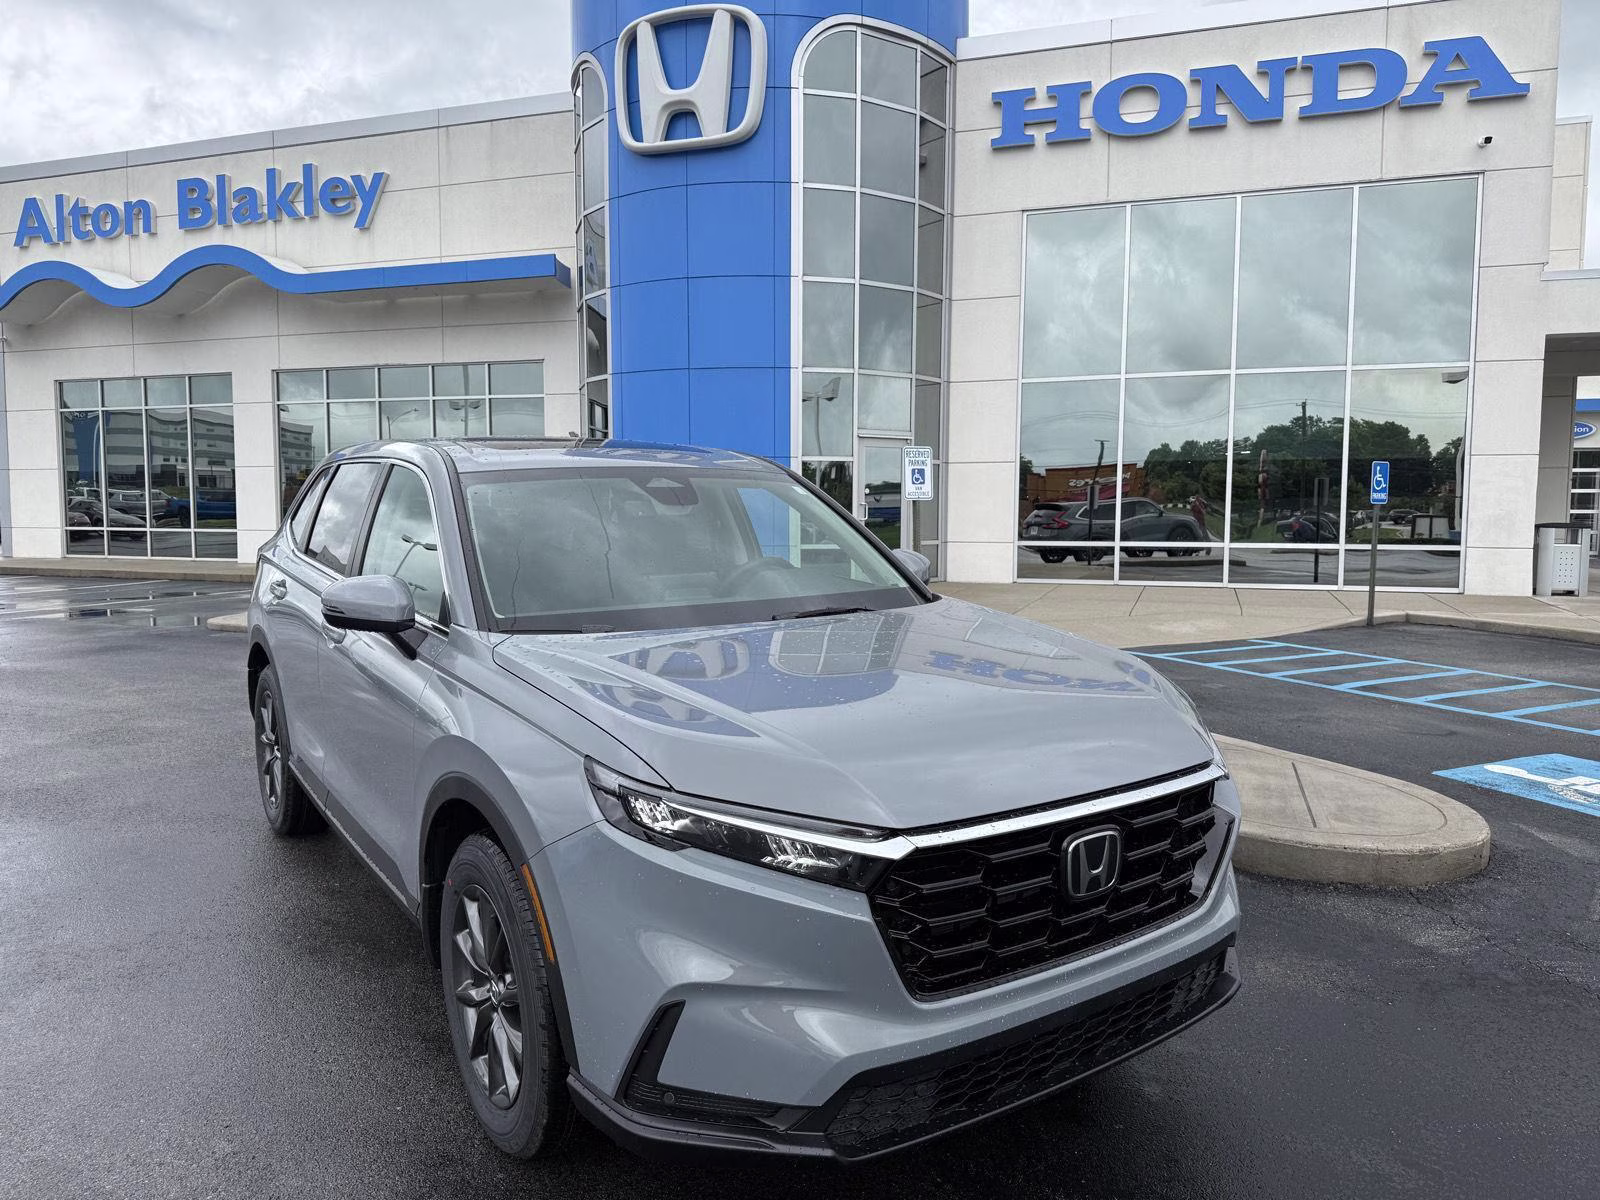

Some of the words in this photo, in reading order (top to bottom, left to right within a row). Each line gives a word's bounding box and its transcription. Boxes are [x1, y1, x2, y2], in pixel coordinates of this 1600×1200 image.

[990, 35, 1531, 149] HONDA
[13, 194, 158, 248] Alton
[176, 163, 390, 230] Blakley
[905, 450, 930, 458] RESERVED
[908, 459, 928, 467] PARKING
